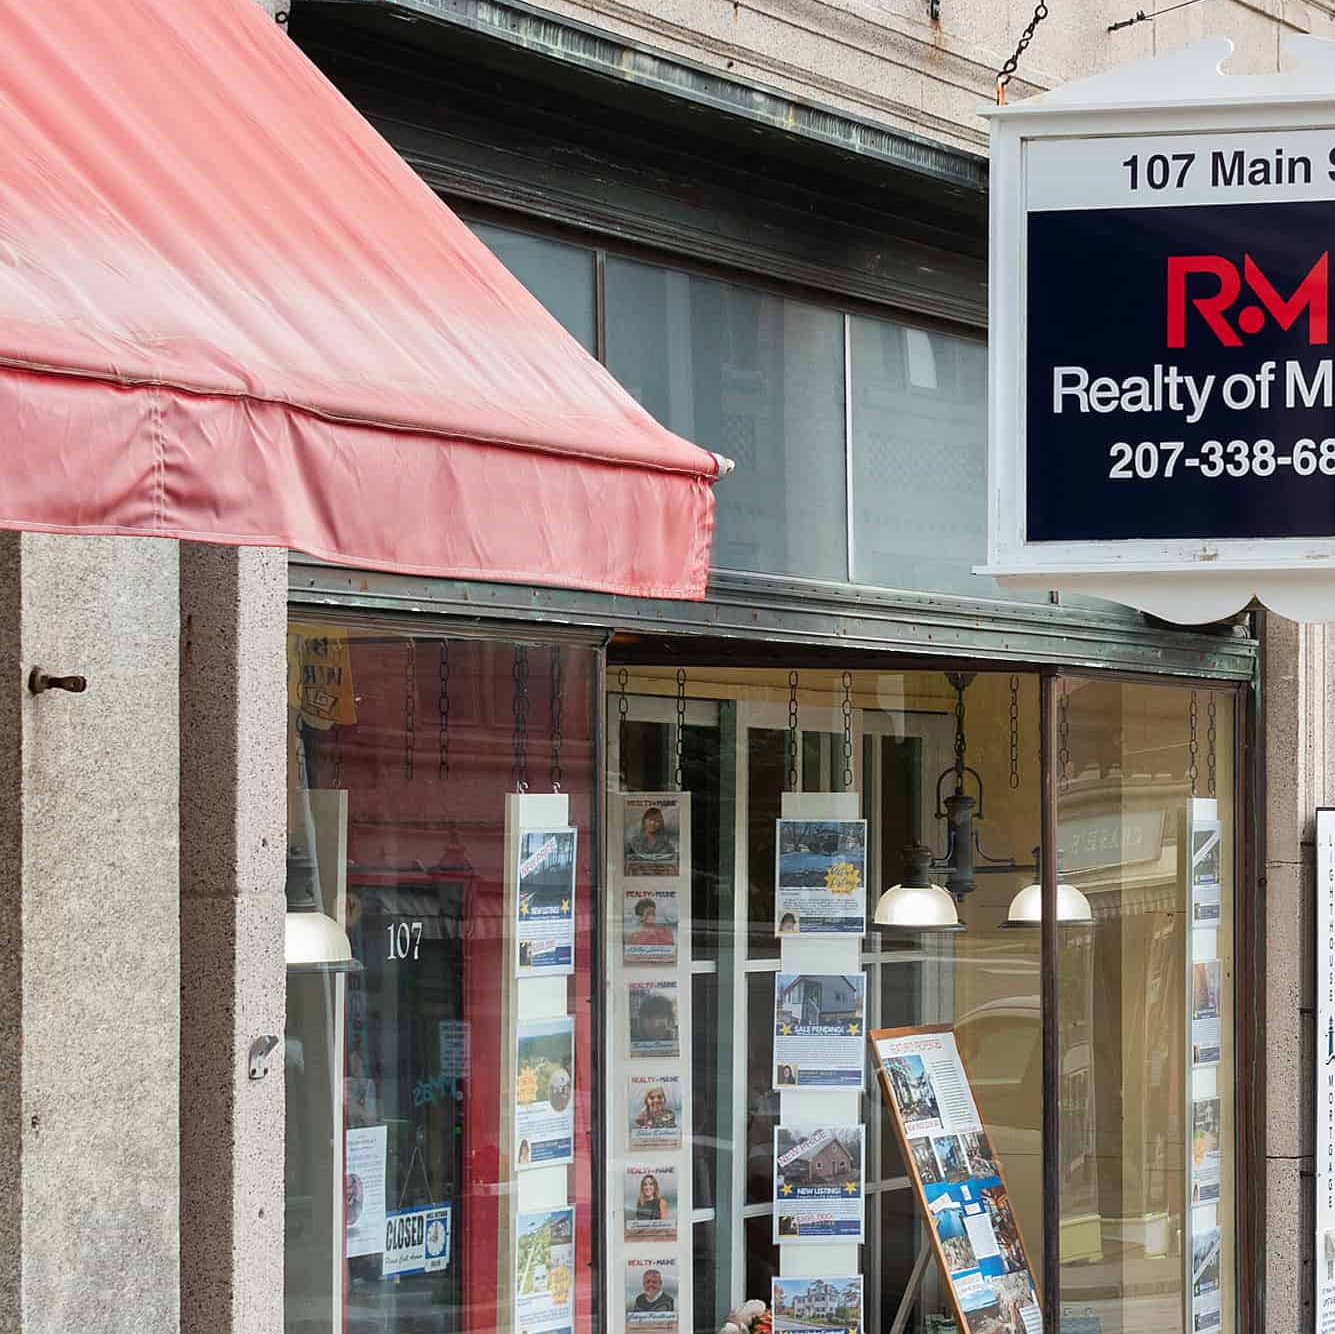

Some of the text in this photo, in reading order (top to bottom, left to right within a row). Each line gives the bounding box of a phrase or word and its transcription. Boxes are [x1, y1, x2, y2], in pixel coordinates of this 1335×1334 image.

[1122, 153, 1197, 190] 107
[1210, 148, 1312, 188] Main
[1052, 364, 1216, 423] Realty
[1223, 362, 1275, 411] of
[387, 922, 423, 960] 107
[386, 1216, 424, 1251] CLOSED
